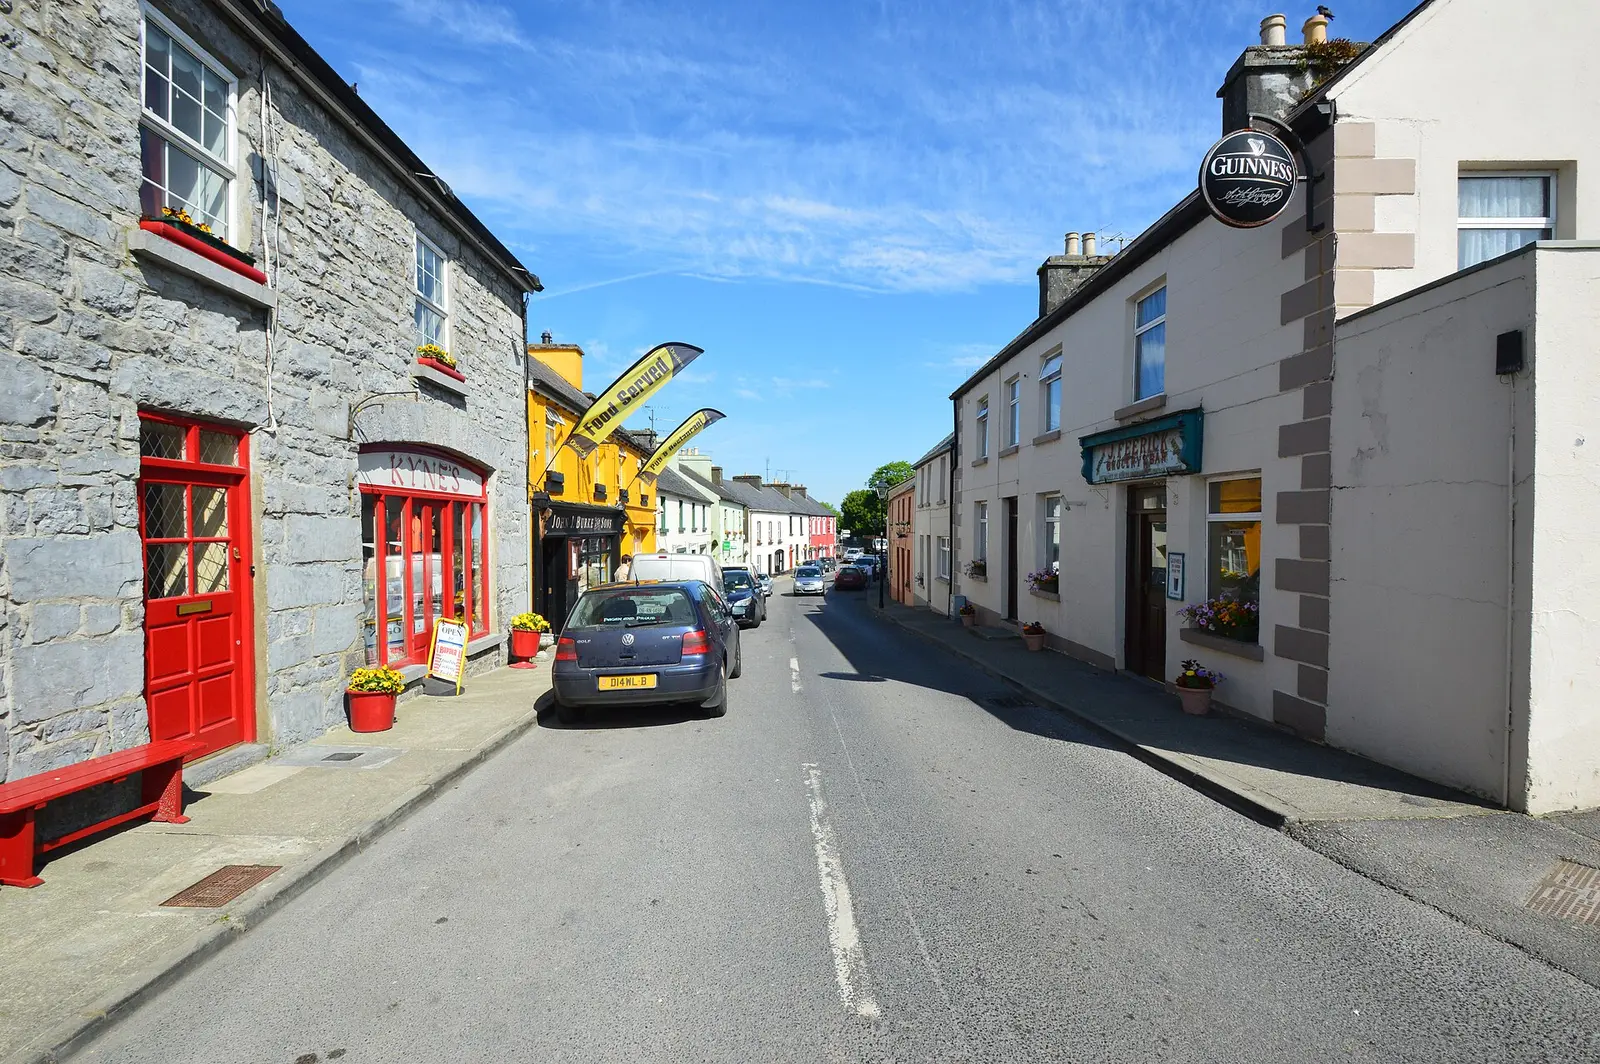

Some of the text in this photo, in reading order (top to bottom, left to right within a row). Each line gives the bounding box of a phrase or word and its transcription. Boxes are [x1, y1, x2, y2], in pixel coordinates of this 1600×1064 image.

[1210, 156, 1293, 182] GUINNESS
[583, 402, 620, 437] Food
[616, 356, 670, 406] Served
[650, 456, 663, 471] Pub
[668, 417, 704, 451] Restaurant
[1117, 432, 1168, 456] FEERICK
[390, 453, 460, 493] KYNE'S
[575, 515, 594, 529] BURKE
[600, 516, 613, 529] SONS
[441, 626, 463, 637] OPEN
